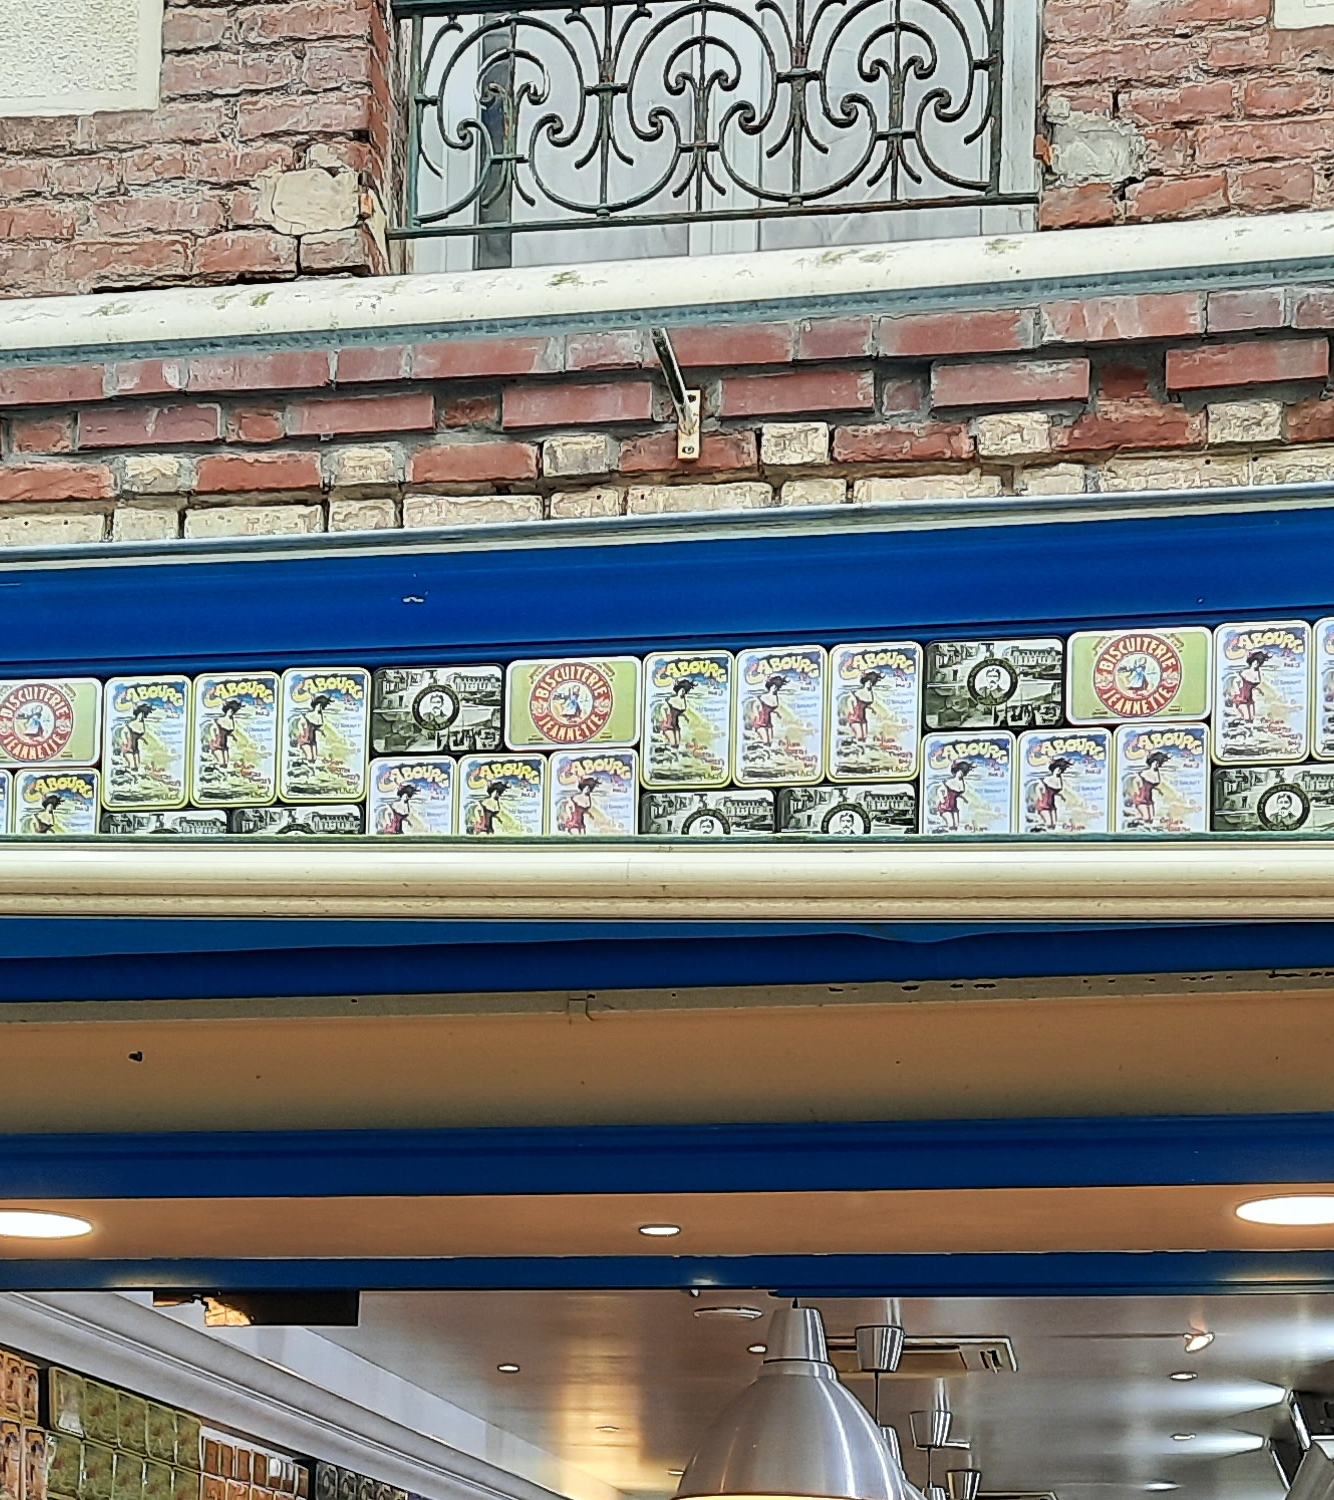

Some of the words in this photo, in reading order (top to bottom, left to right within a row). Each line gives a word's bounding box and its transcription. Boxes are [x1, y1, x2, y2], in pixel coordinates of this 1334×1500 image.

[1100, 636, 1176, 671] BISCUITERIE
[1226, 630, 1304, 660] CABOURG
[539, 663, 605, 698] BISCUITERIE
[653, 659, 727, 687] CABOURG
[745, 655, 819, 684] CABOURG
[838, 651, 914, 680] CABOURG
[113, 684, 183, 711] CABOURG
[203, 680, 273, 707] CABOURG
[291, 675, 363, 702] CABOURG
[1100, 686, 1173, 717] JEANNETTE
[539, 714, 604, 741] JEANNETTE
[3, 735, 68, 762] JEANNETTE
[929, 737, 1008, 768] CABOURG
[1026, 735, 1105, 765] CABOURG
[1124, 730, 1203, 760] CABOURG
[377, 763, 450, 793] CABOURG
[467, 759, 540, 789] CABOURG
[558, 755, 631, 785] CABOURG
[23, 772, 93, 802] CABOURG
